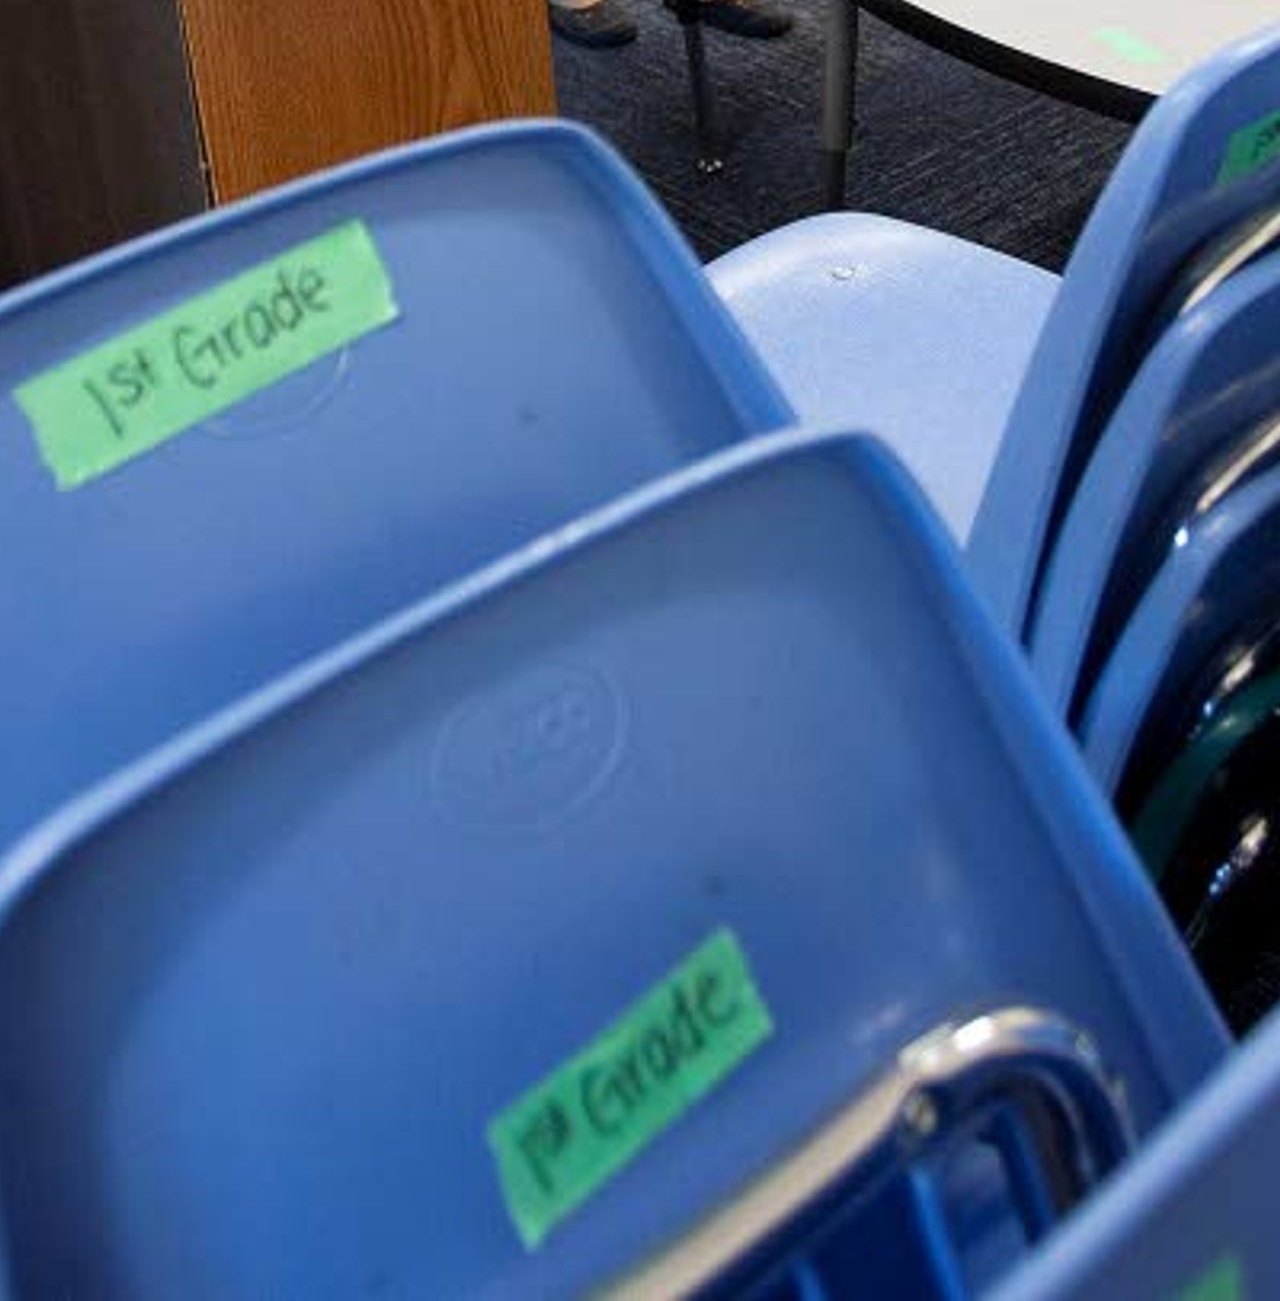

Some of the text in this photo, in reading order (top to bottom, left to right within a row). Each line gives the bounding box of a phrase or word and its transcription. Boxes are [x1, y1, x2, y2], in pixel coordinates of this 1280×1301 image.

[81, 264, 334, 438] 1st Grade
[582, 971, 739, 1139] Grade
